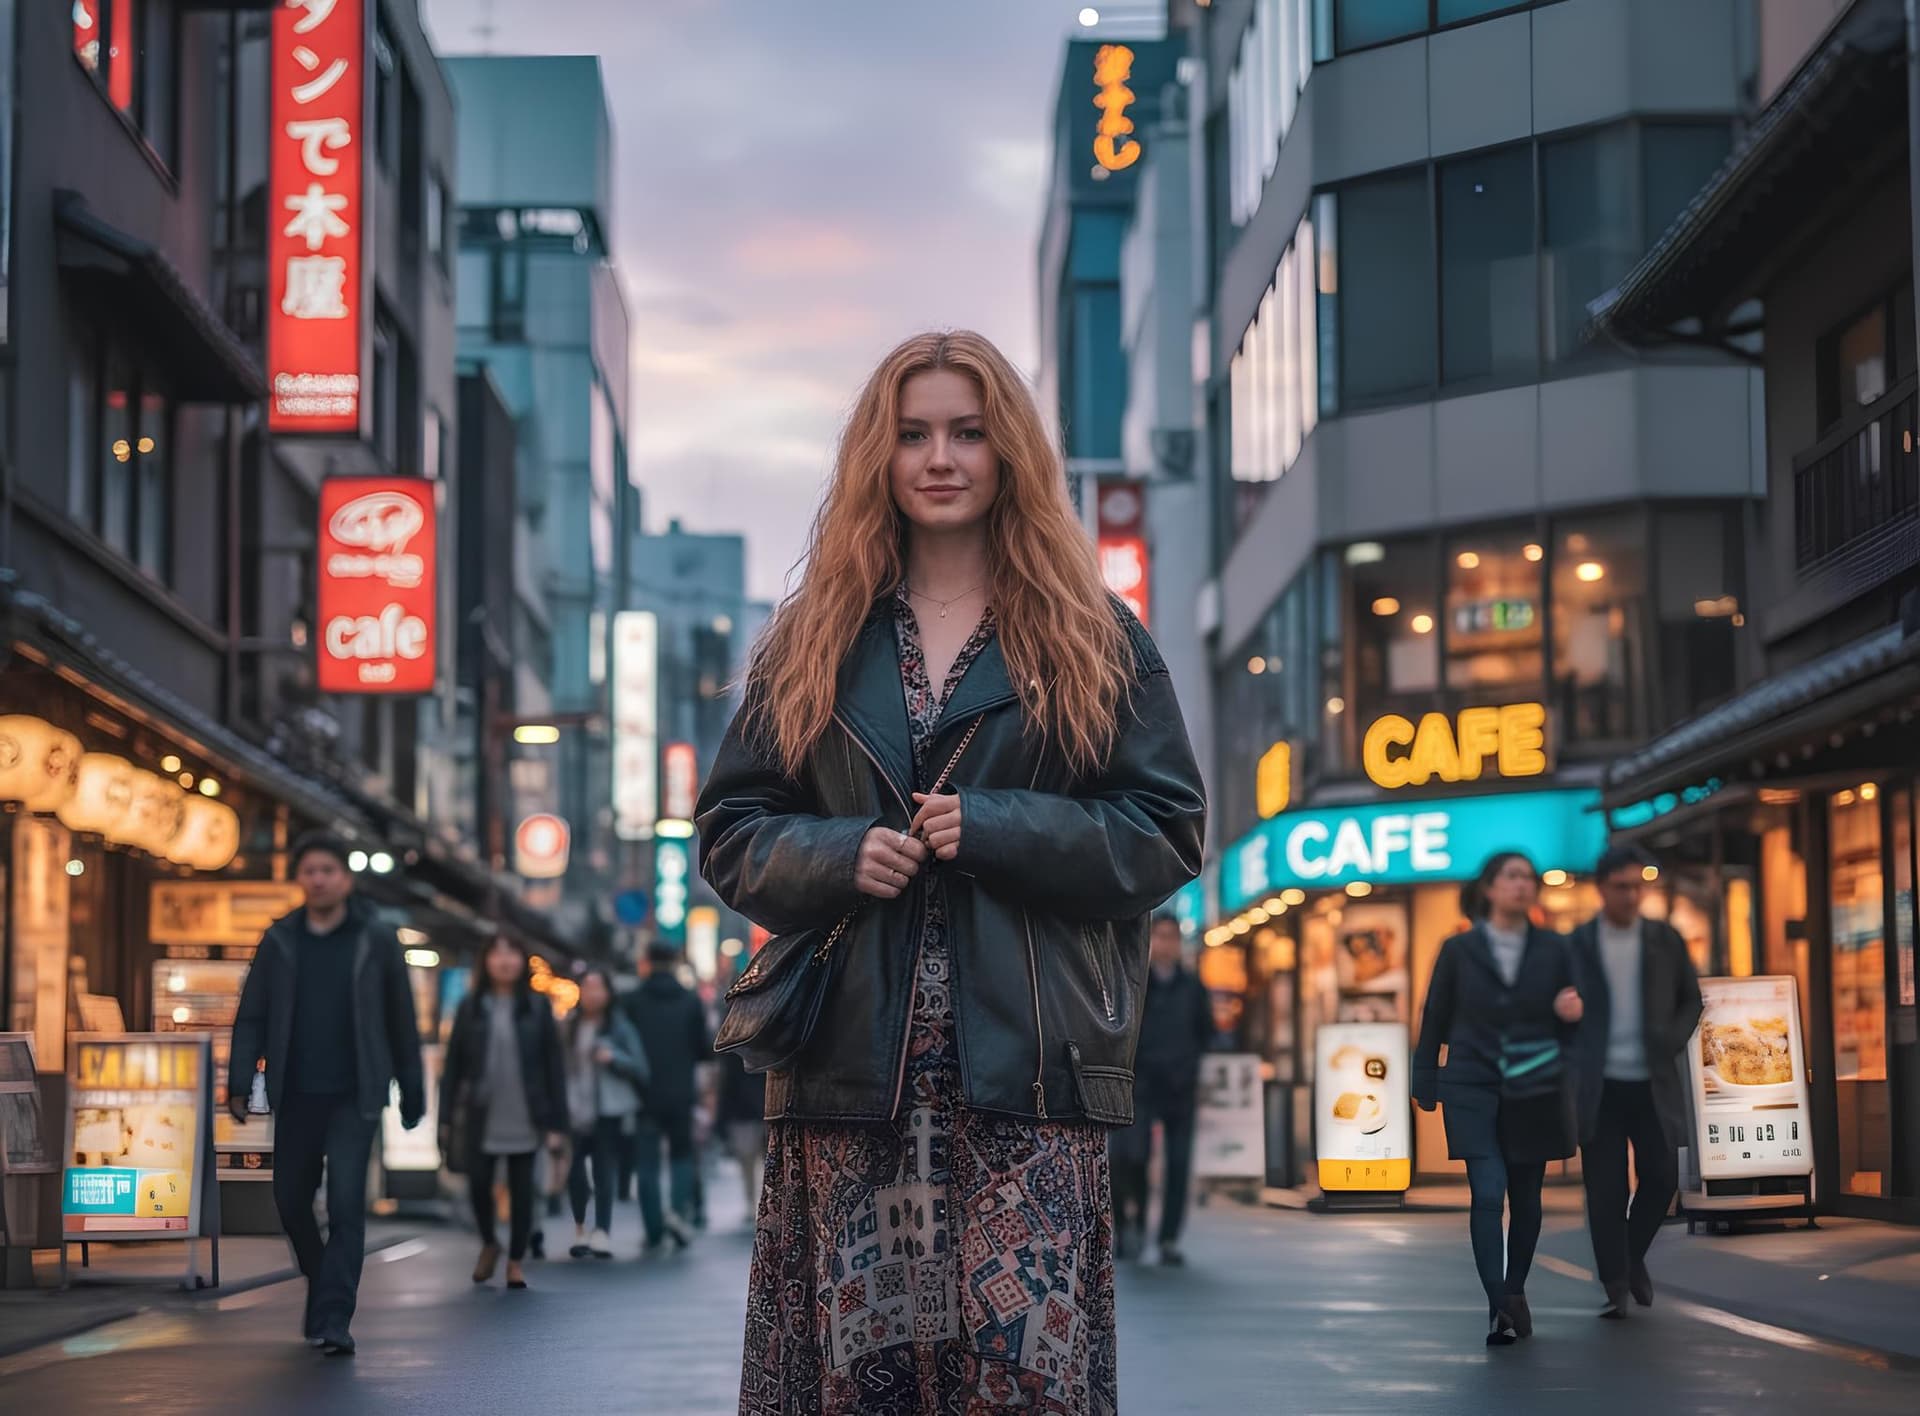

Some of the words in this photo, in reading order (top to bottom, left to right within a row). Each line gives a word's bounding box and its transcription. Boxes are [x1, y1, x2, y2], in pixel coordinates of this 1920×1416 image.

[326, 603, 427, 659] cafe
[1363, 702, 1546, 789] CAFE
[1286, 812, 1451, 879] CAFE
